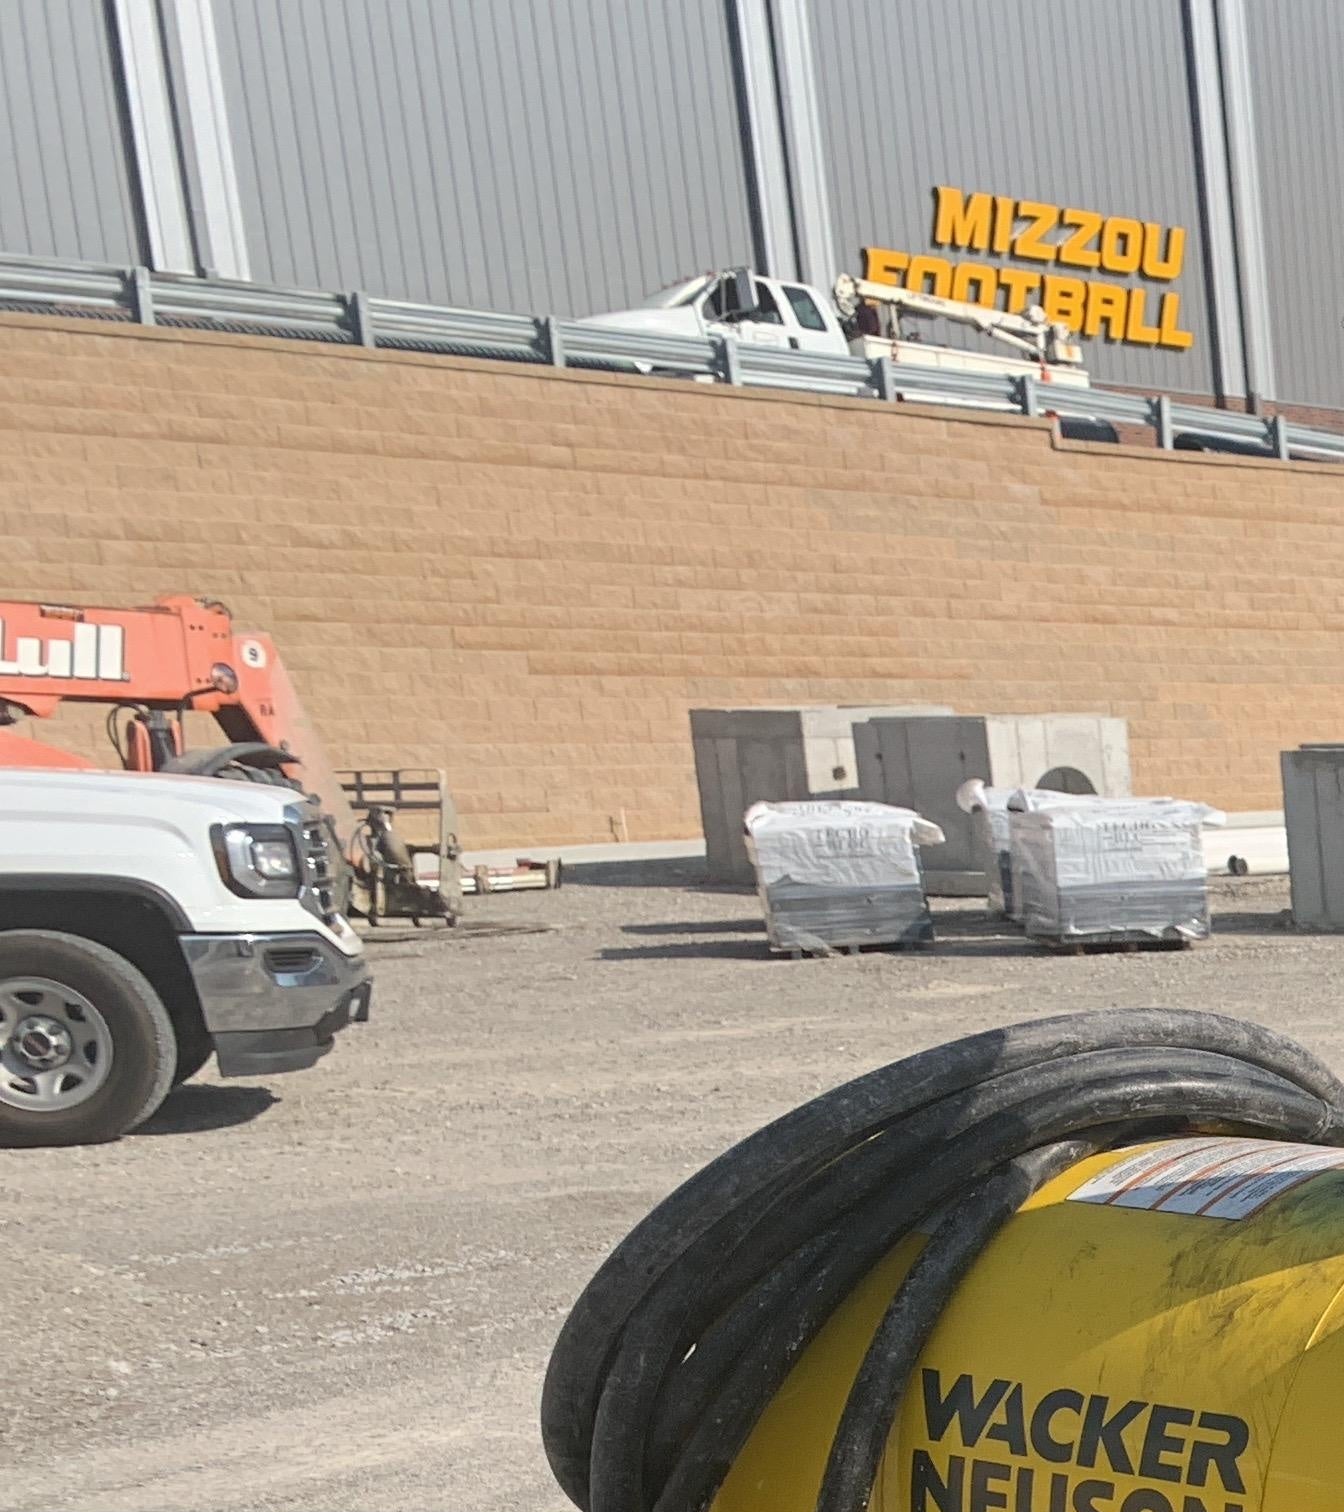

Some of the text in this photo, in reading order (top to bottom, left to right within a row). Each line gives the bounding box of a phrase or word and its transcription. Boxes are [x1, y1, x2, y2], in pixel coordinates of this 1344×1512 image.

[936, 186, 1186, 280] MIZZOU
[866, 248, 1194, 348] FOOTBALL
[922, 1368, 1250, 1495] WACKER
